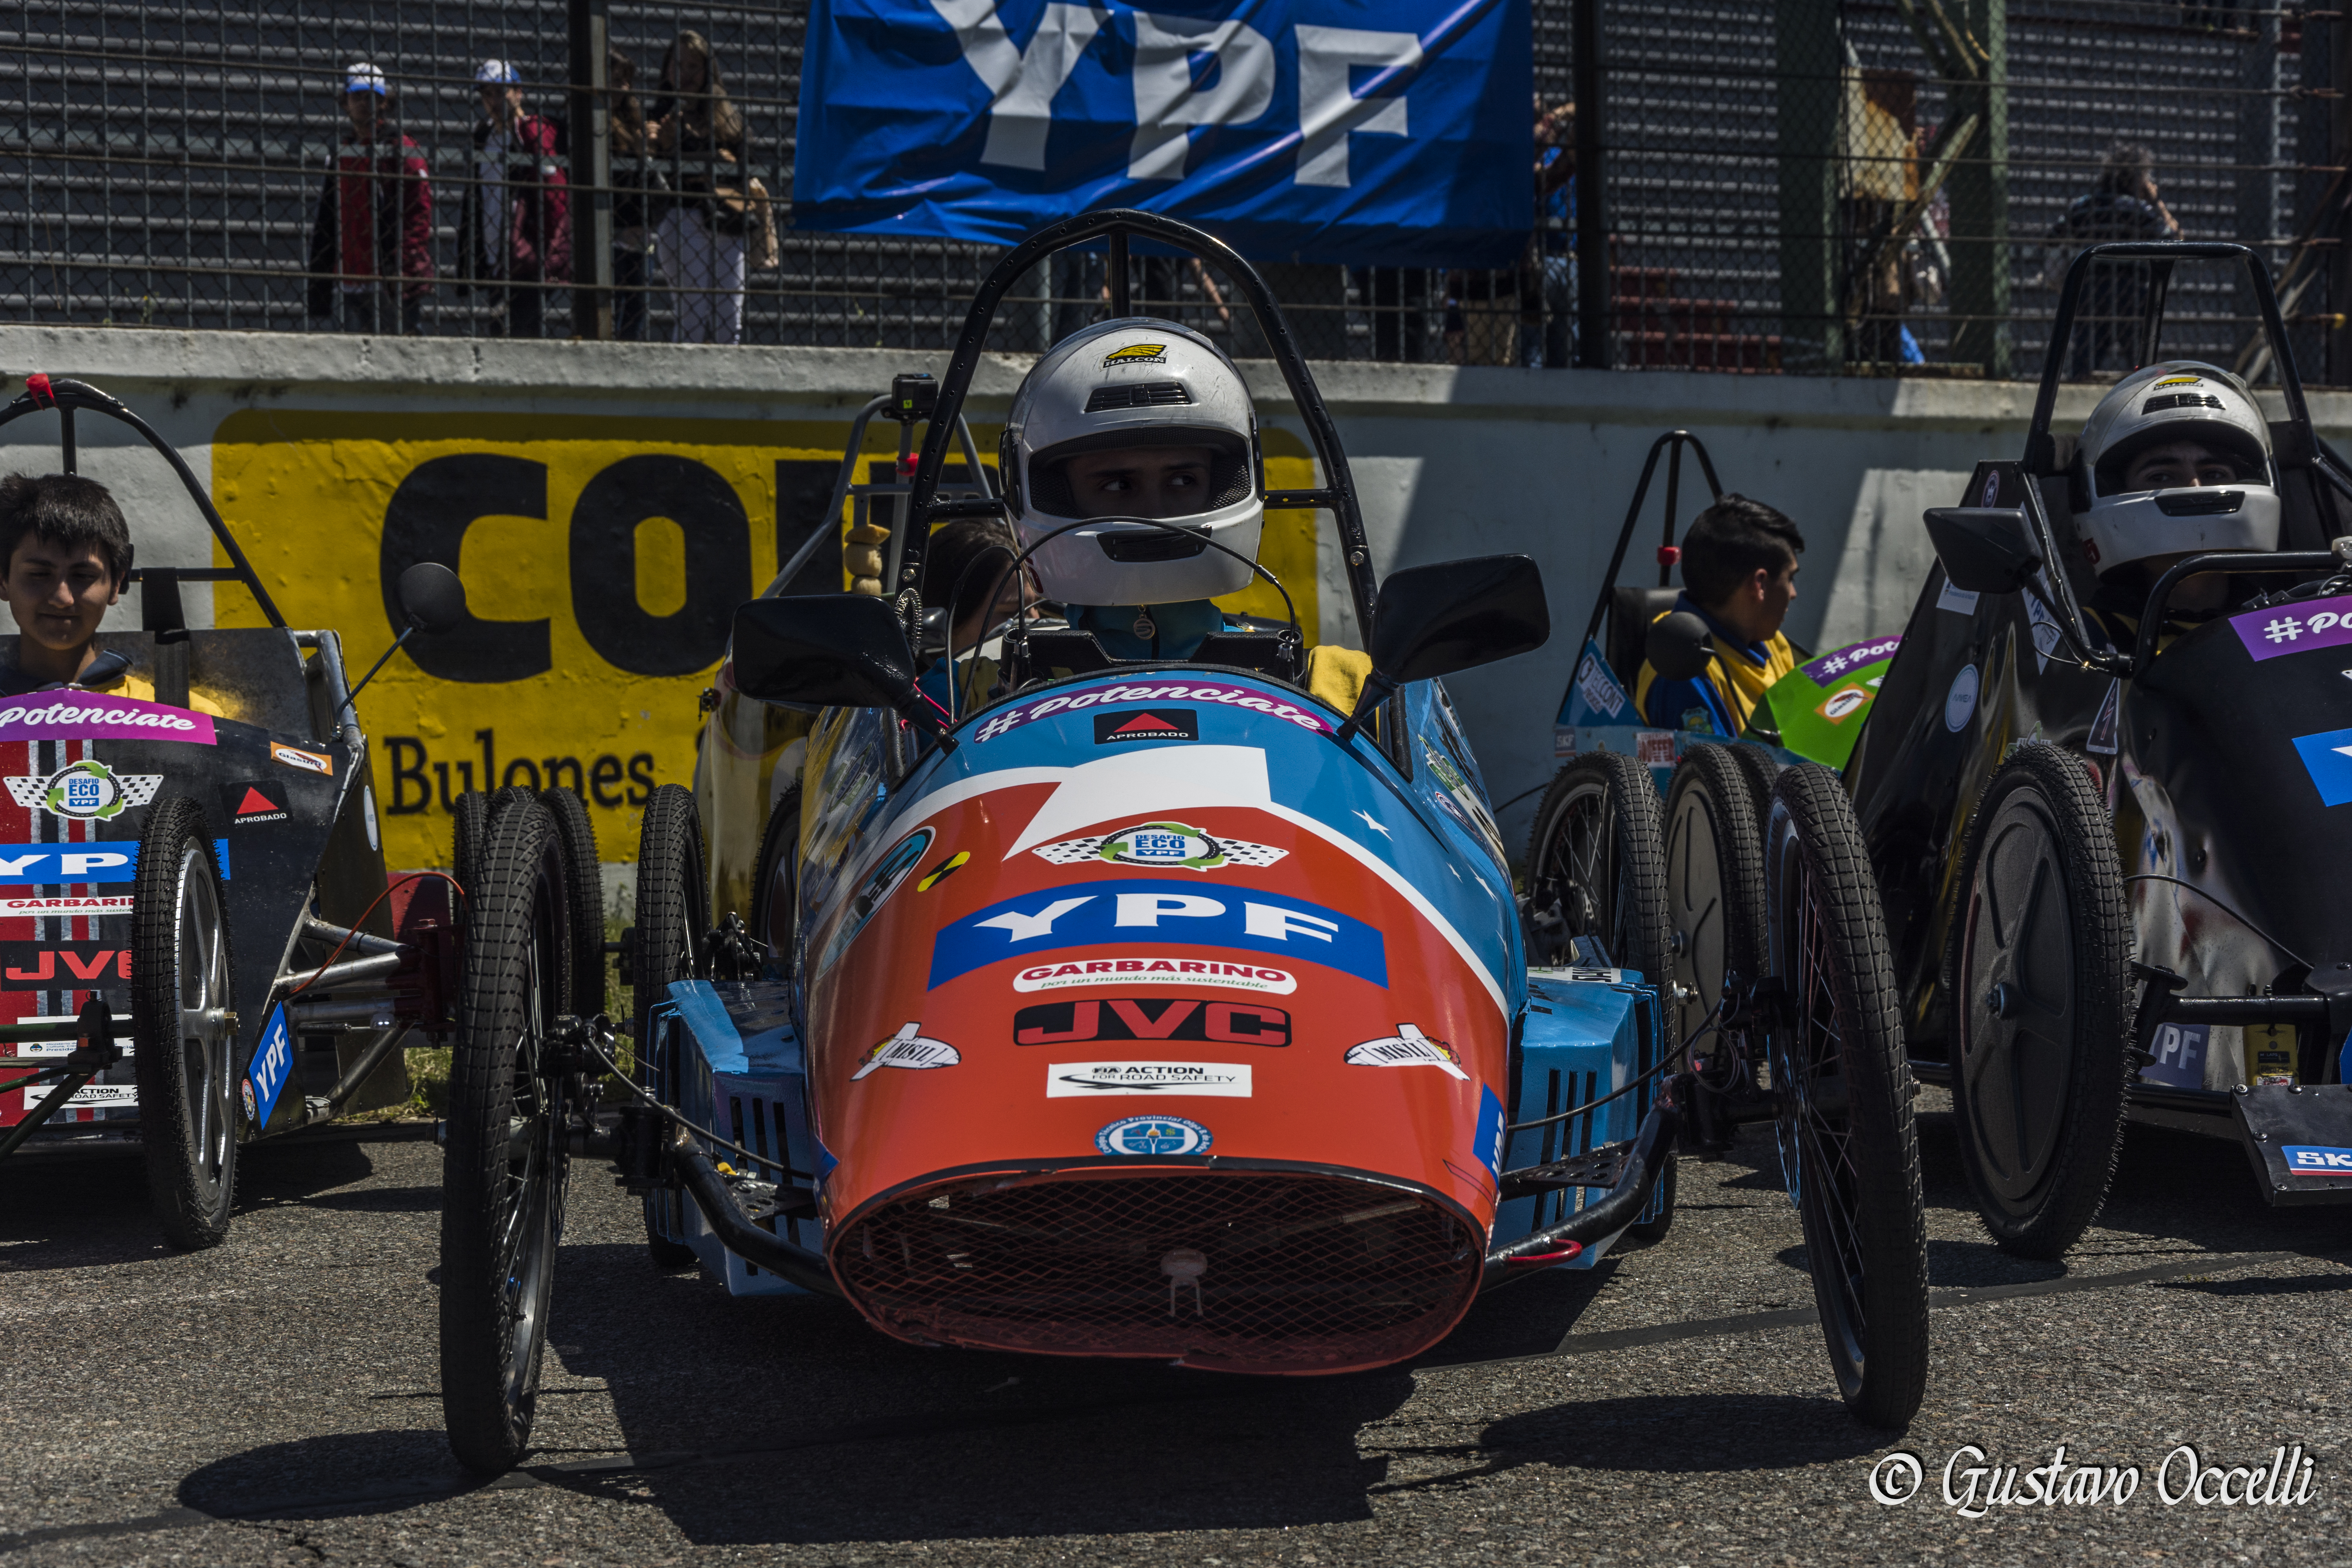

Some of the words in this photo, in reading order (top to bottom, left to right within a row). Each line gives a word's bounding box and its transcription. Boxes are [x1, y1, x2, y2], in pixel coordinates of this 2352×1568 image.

[929, 0, 1424, 188] YPF
[1105, 357, 1165, 367] HALCON
[2154, 382, 2203, 391] HALCON
[1106, 732, 1189, 741] APROBADO
[386, 727, 655, 817] Bulones
[69, 784, 100, 796] ECO
[234, 813, 287, 824] APROBADO
[1135, 839, 1185, 849] ECO
[0, 853, 129, 876] YP
[7, 898, 134, 908] GARBARI
[974, 893, 1339, 943] YPF
[6, 950, 132, 980] JV
[1022, 960, 1286, 982] GARBARINO
[1040, 980, 1067, 989] por
[1184, 976, 1268, 989] sustentable
[1018, 1000, 1286, 1046] JVC
[256, 1023, 285, 1103] YPF
